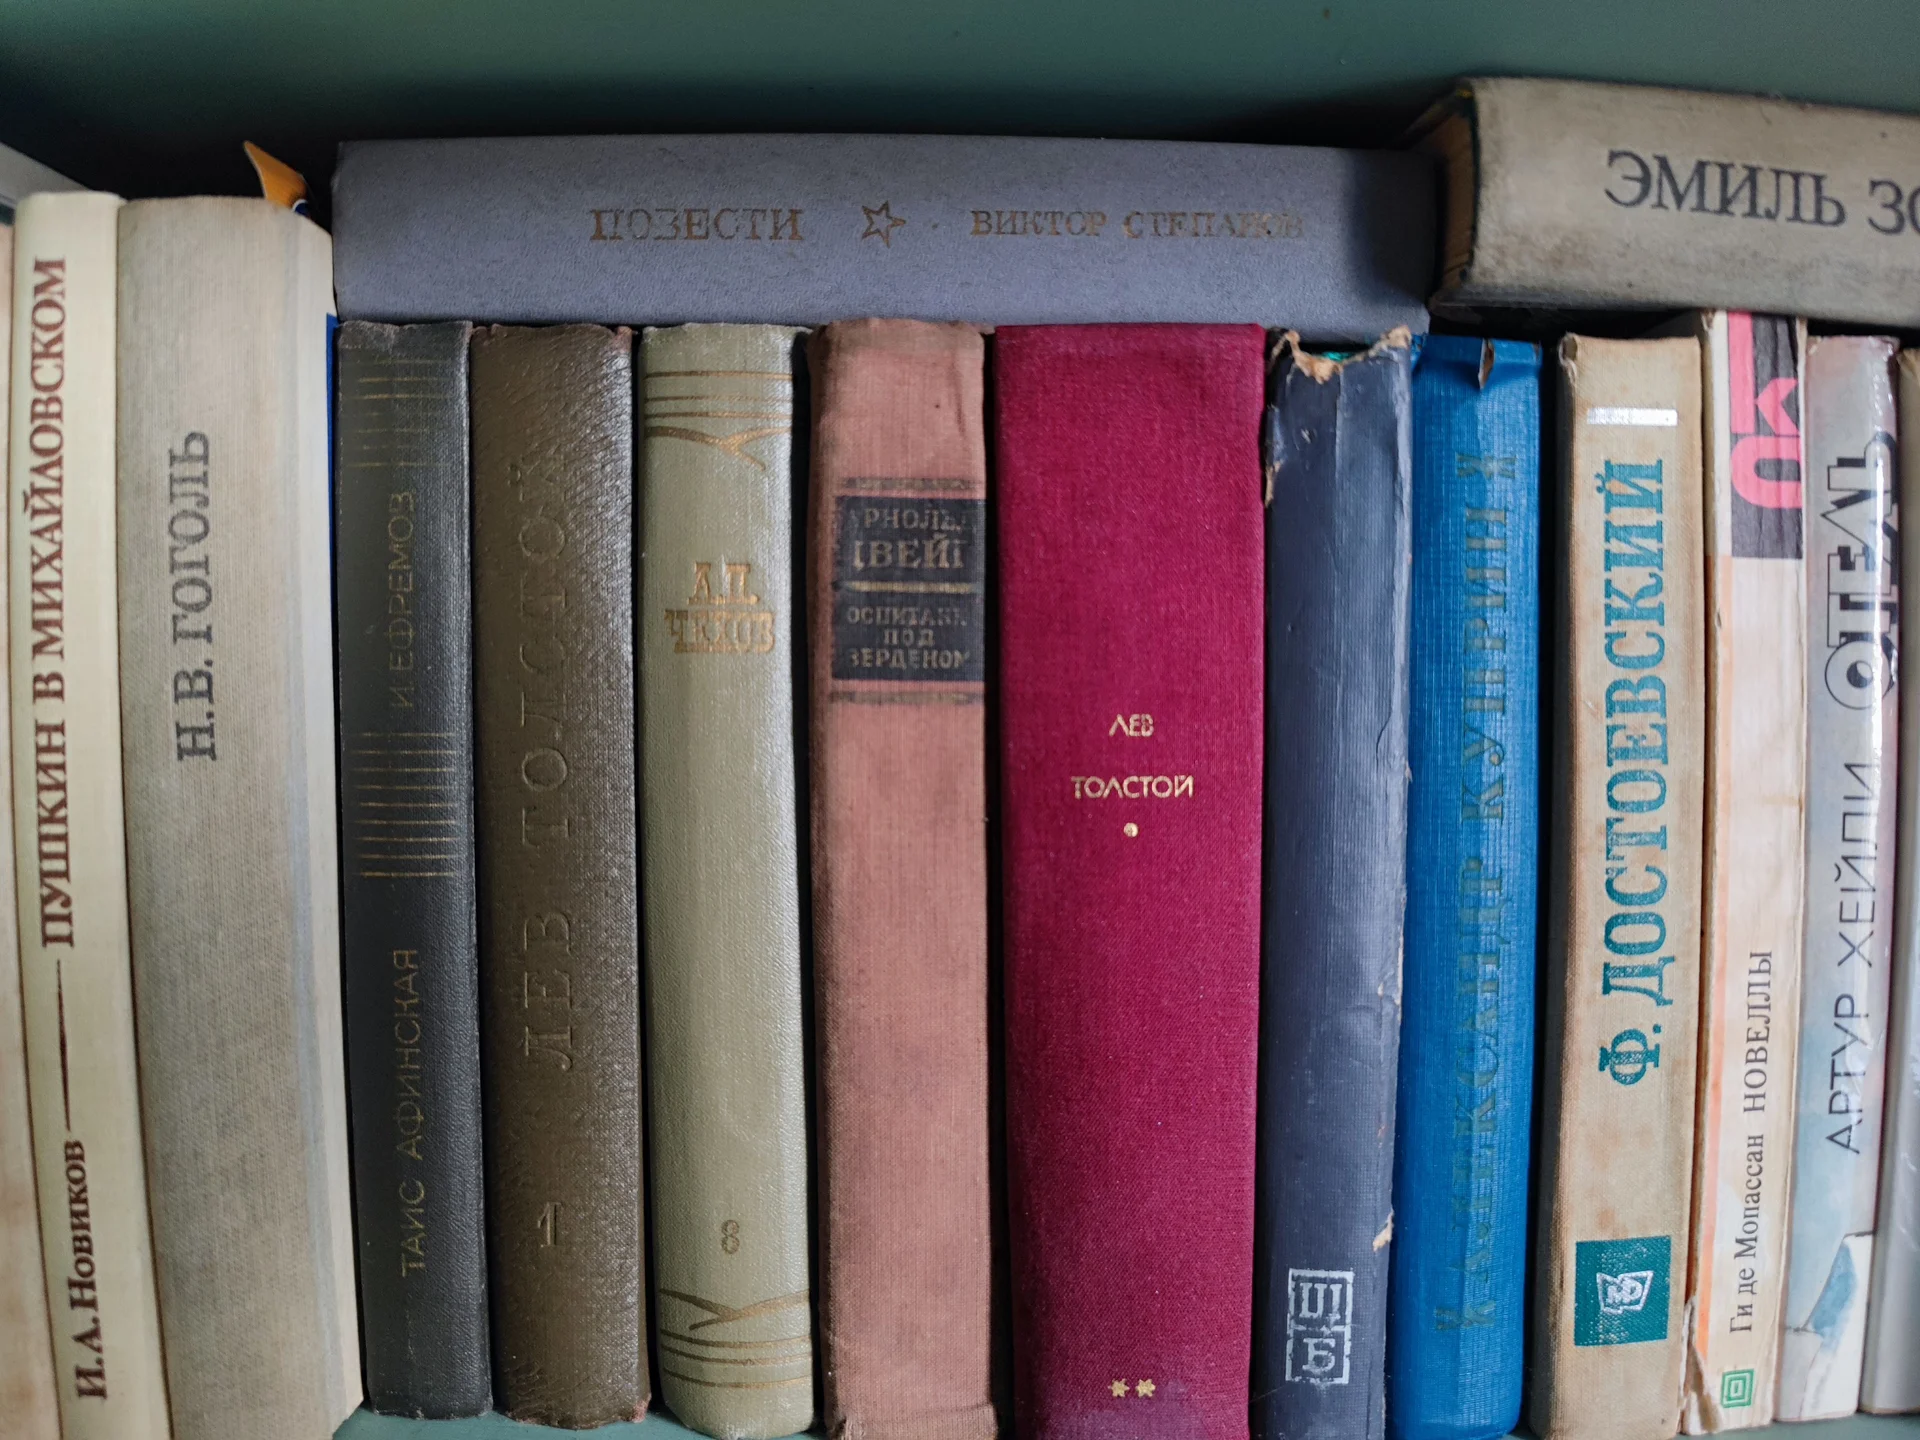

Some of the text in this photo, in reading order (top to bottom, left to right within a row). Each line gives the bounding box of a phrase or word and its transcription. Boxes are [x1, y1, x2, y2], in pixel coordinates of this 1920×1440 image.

[970, 209, 1107, 237] ВИКТОР
[1604, 149, 1846, 228] ЭМИЛЬ
[23, 255, 75, 949] ПУШКИН В МИХАЙЛОВСКОМ
[167, 431, 217, 762] Н.В. ГОГОЛЬ
[385, 490, 417, 670] ЕФРЕМОВ
[687, 561, 760, 605] А.П.
[883, 628, 936, 648] ПОД
[1820, 431, 1899, 711] ОТЕЛЬ
[1070, 774, 1195, 800] ТОЛСТОЙ
[1108, 713, 1155, 737] ЛЕВ
[1596, 458, 1677, 1088] Ф. ДОСТОЕВСКИЙ
[523, 911, 574, 1072] ЛЕВ
[1449, 506, 1511, 1285] АЛЕКСАНДР КУПРИН
[1825, 762, 1881, 1155] АРТУР ХЕЙЛИ
[392, 949, 428, 1278] ТАИС АФИНСКАЯ
[1729, 951, 1773, 1334] Ги де Мопассан НОВЕЛЛЫ
